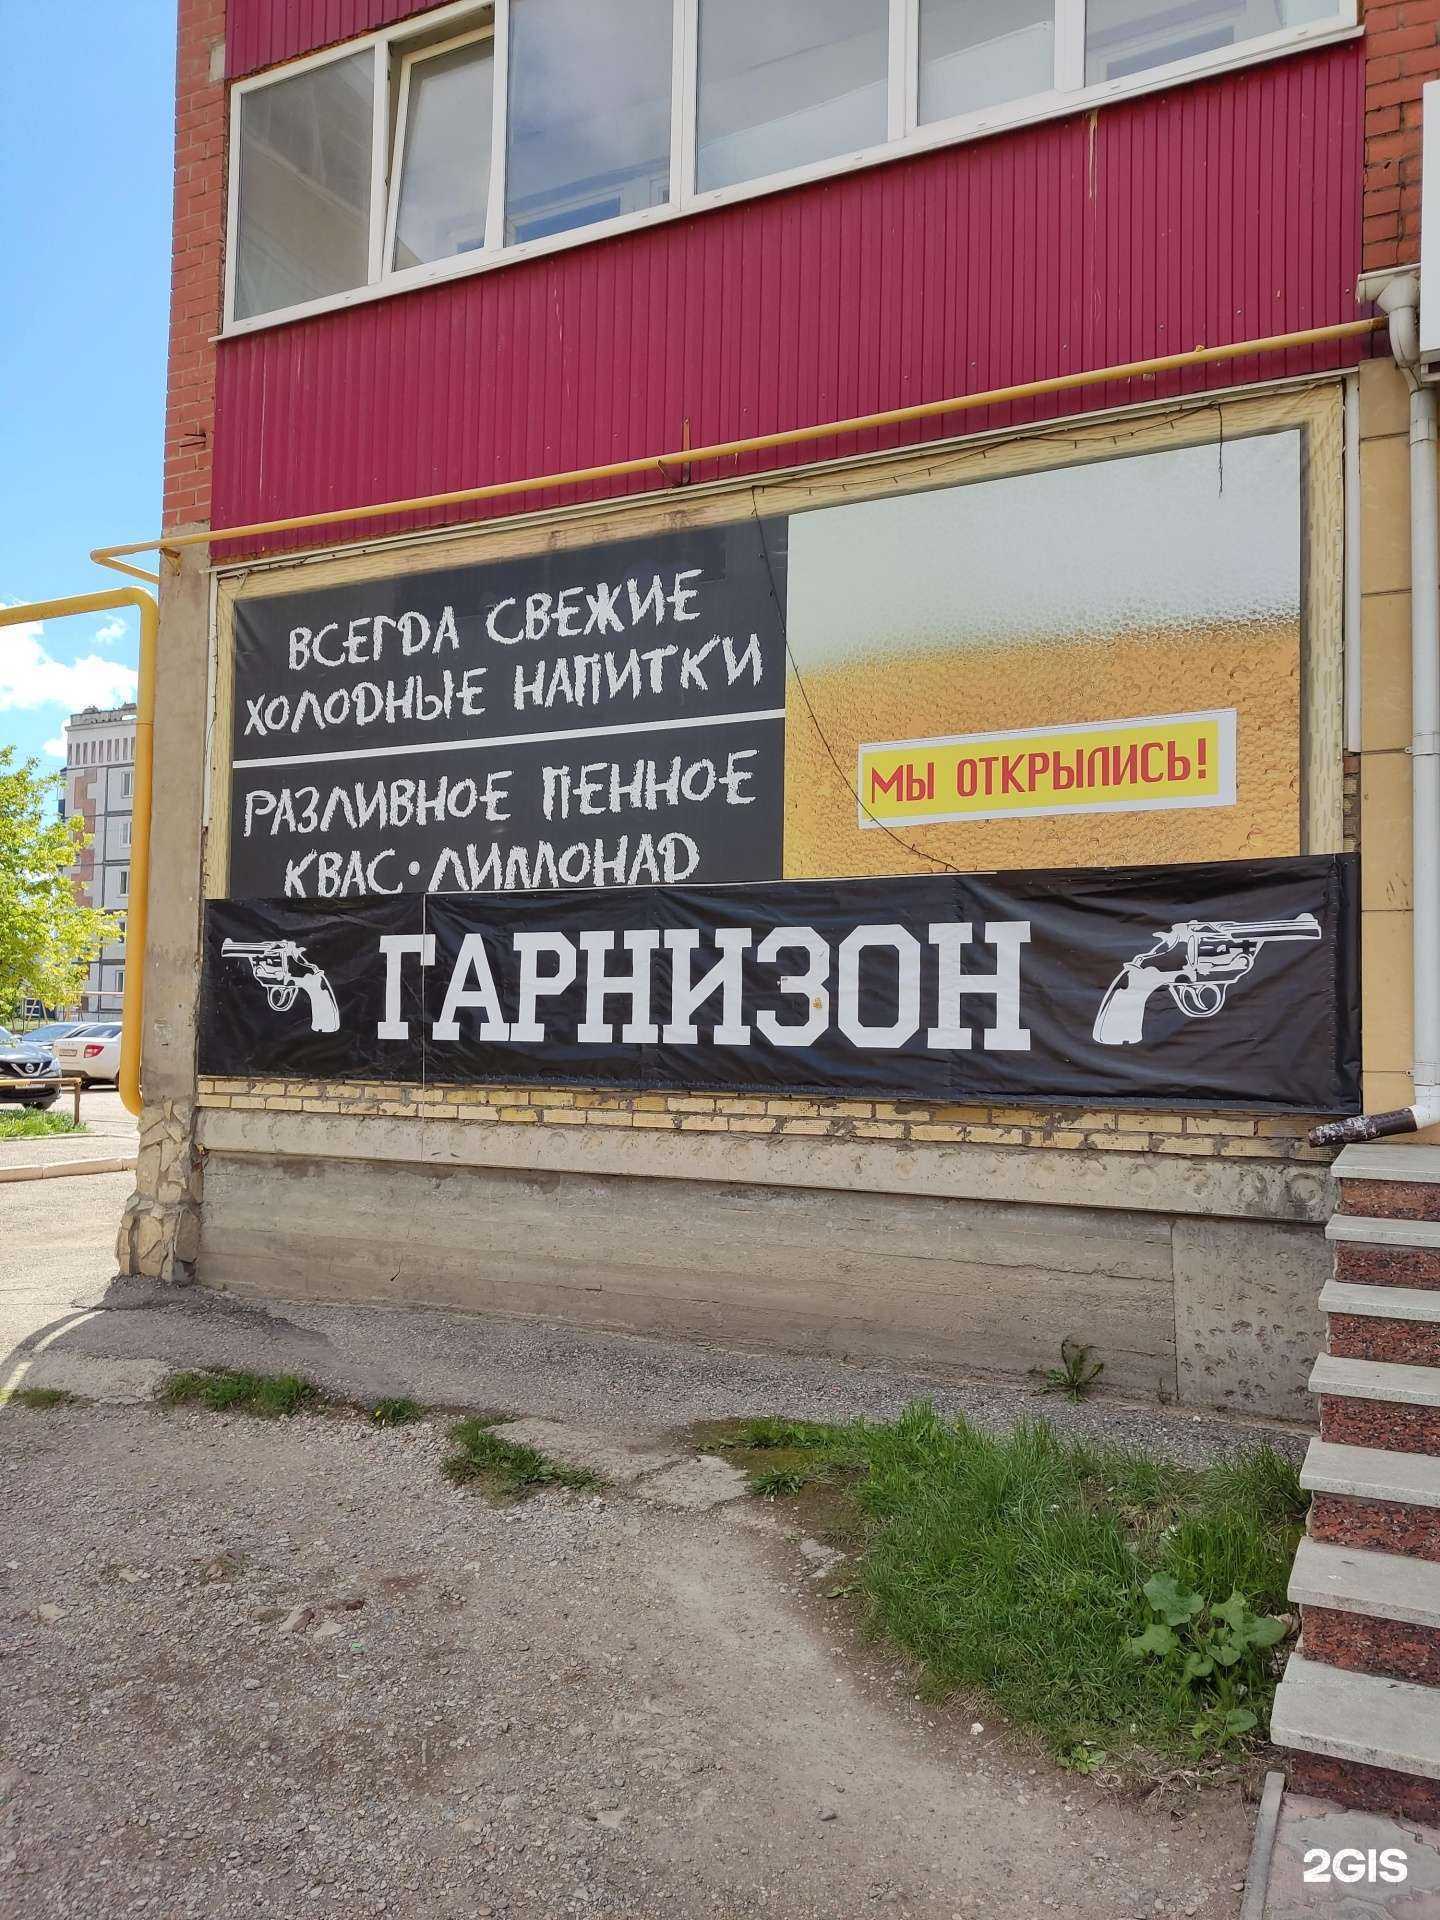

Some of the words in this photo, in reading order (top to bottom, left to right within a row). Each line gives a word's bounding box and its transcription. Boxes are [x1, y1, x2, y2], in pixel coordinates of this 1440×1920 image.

[288, 605, 459, 672] ВСЕГДА
[486, 568, 702, 645] СВЕЖИЕ
[244, 668, 488, 736] ХОЛОДНЫЕ
[514, 633, 763, 710] НАПИТКИ
[243, 770, 513, 837] РАЗЛИВНОЕ
[542, 749, 759, 820] ПЕННОЕ
[871, 762, 935, 804] МЫ
[956, 737, 1208, 798] ОТКРЫЛИСЬ!
[284, 848, 403, 898] КВАС
[377, 920, 1031, 1051] ГАРНИЗОН
